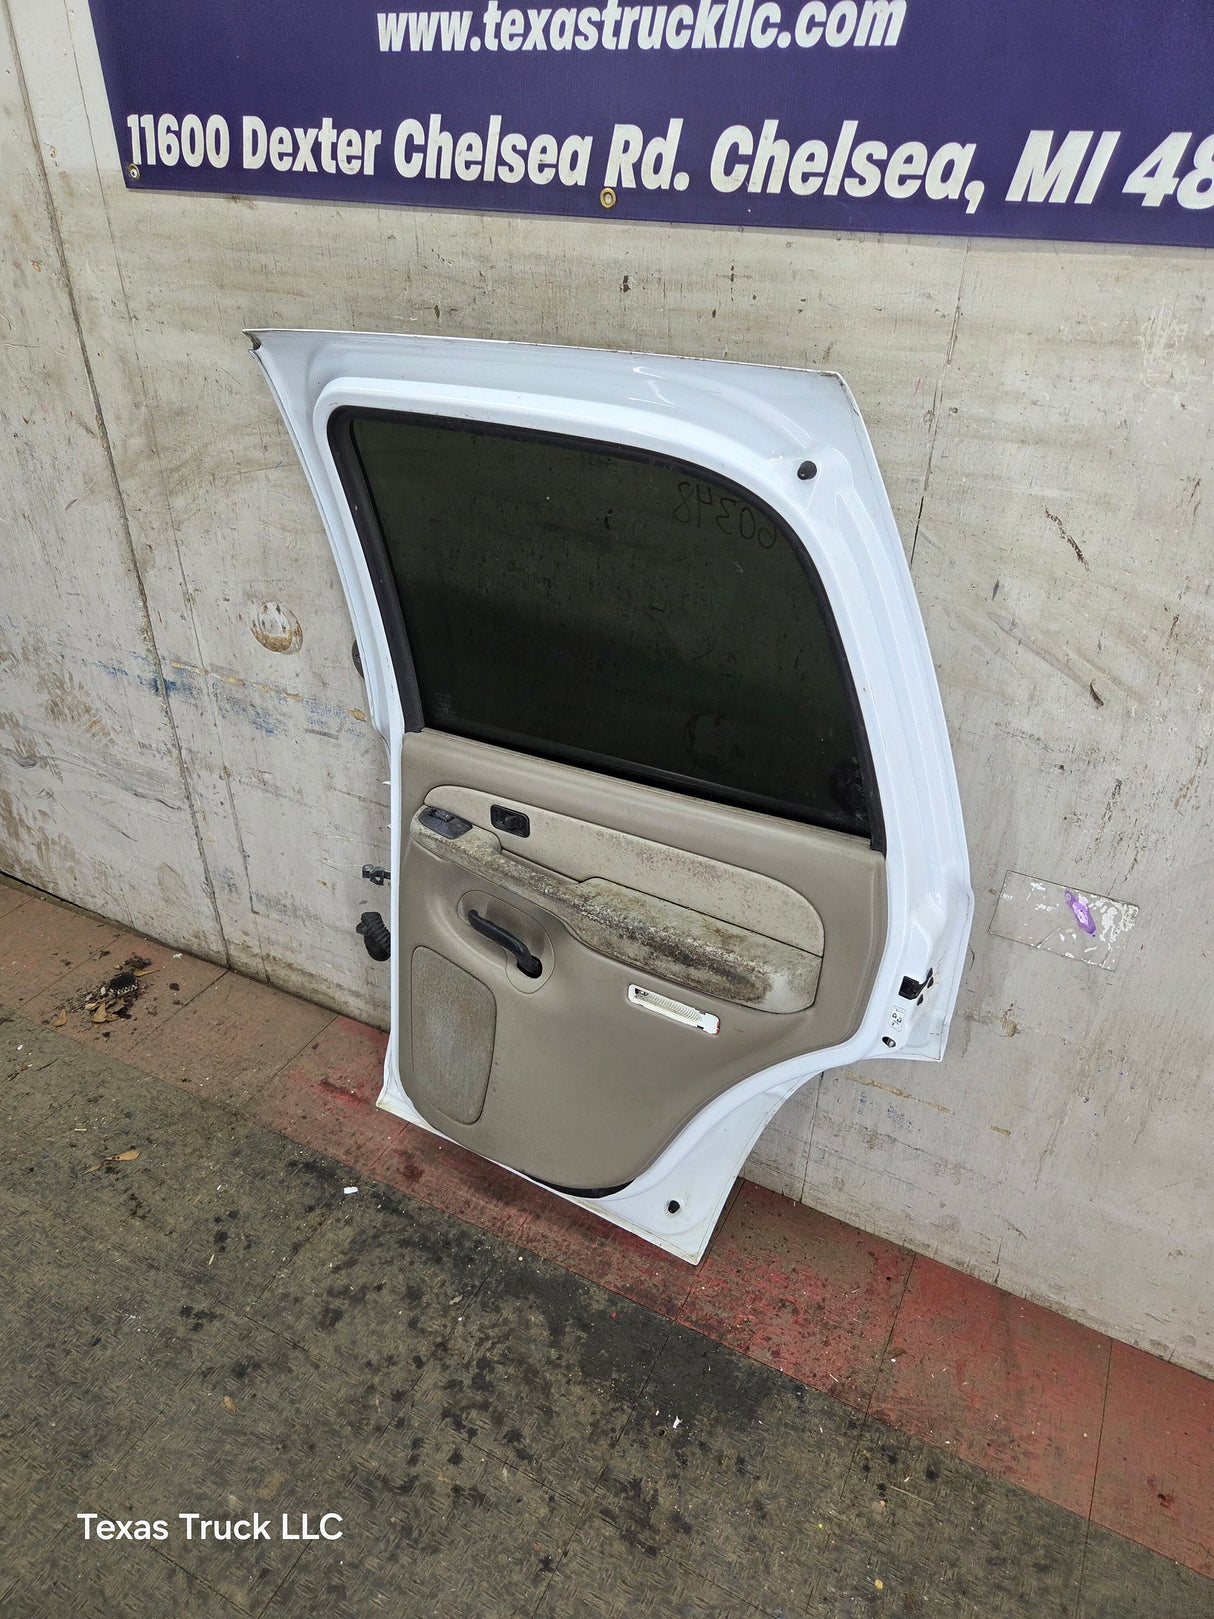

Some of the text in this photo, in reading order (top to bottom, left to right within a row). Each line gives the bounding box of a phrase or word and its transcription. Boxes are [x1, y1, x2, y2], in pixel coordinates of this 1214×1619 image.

[376, 0, 907, 52] www.texastruckllc.com
[126, 113, 231, 169] 11600
[242, 115, 383, 176] Dexter
[393, 113, 595, 187] Chelsea
[603, 117, 690, 192] Rd.
[709, 119, 985, 215] Chelsea,
[1004, 129, 1122, 205] MI
